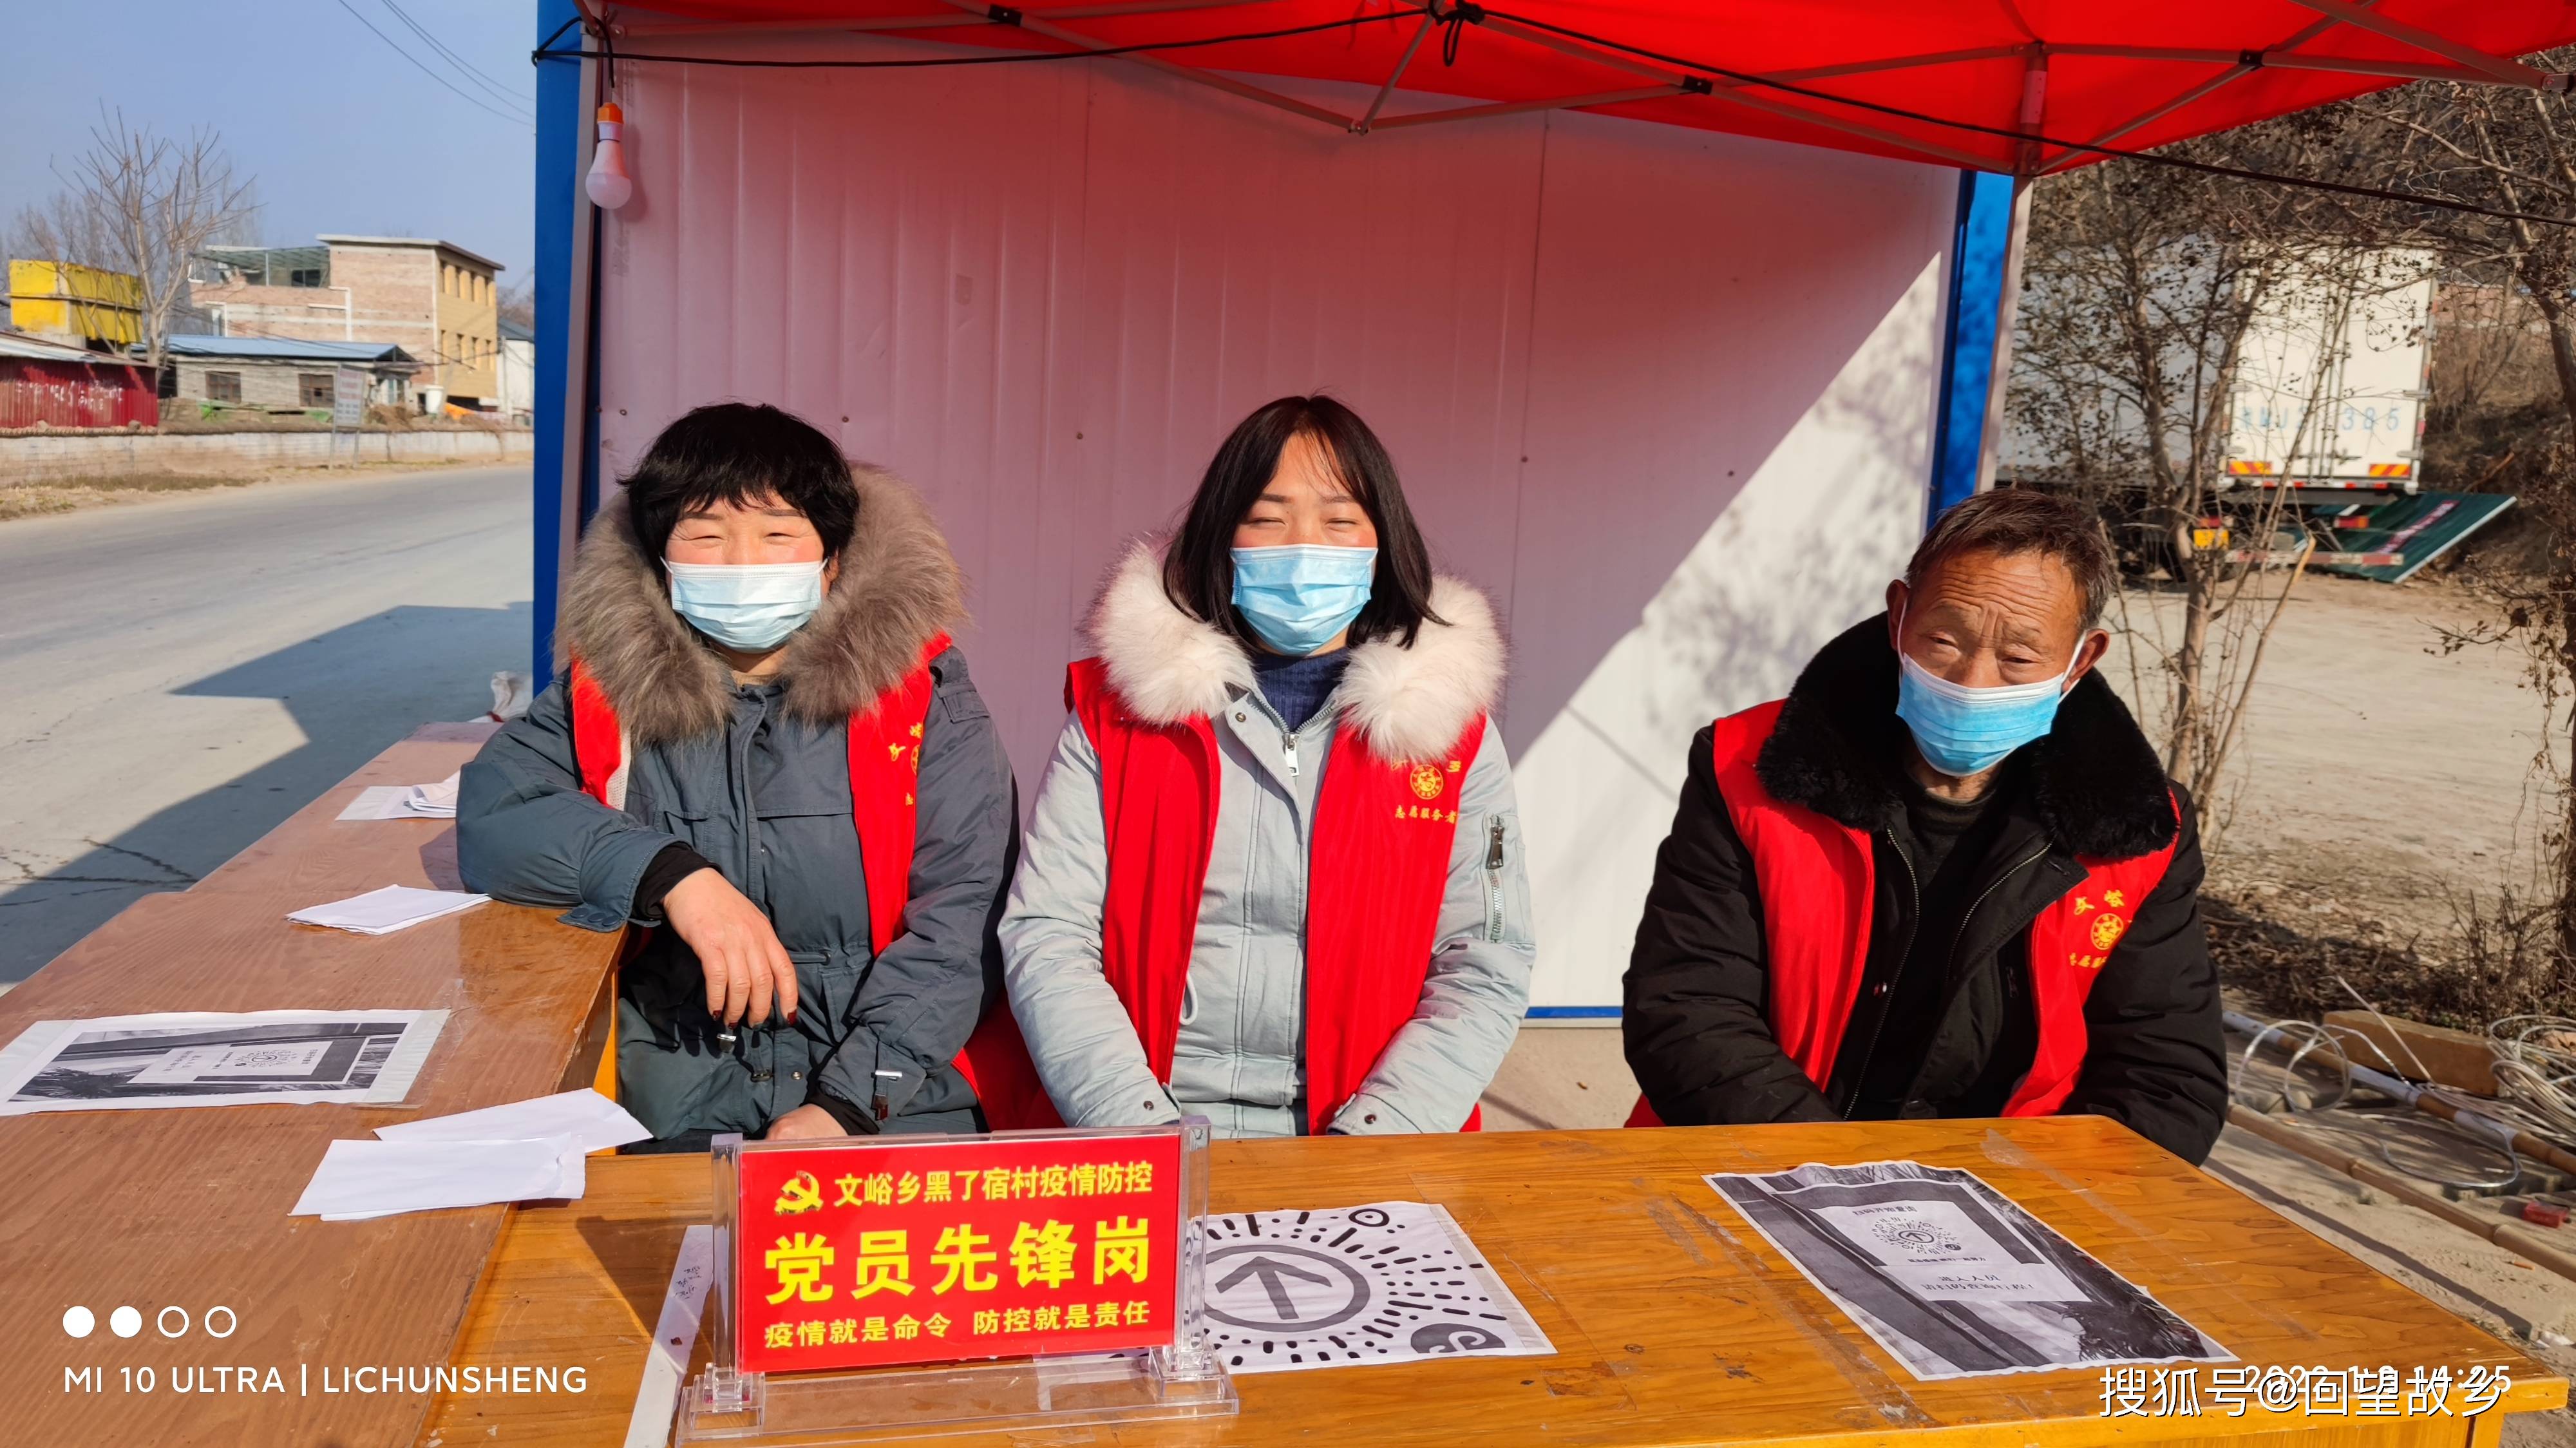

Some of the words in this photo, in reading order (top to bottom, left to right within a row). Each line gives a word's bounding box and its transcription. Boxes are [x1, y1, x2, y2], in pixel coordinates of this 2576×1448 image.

[834, 1161, 1153, 1207] 文峪乡黑了宿村疫情防控
[764, 1215, 1150, 1305] 党员先锋岗
[764, 1311, 952, 1349] 疫情就是命令
[973, 1300, 1150, 1335] 防控就是责任
